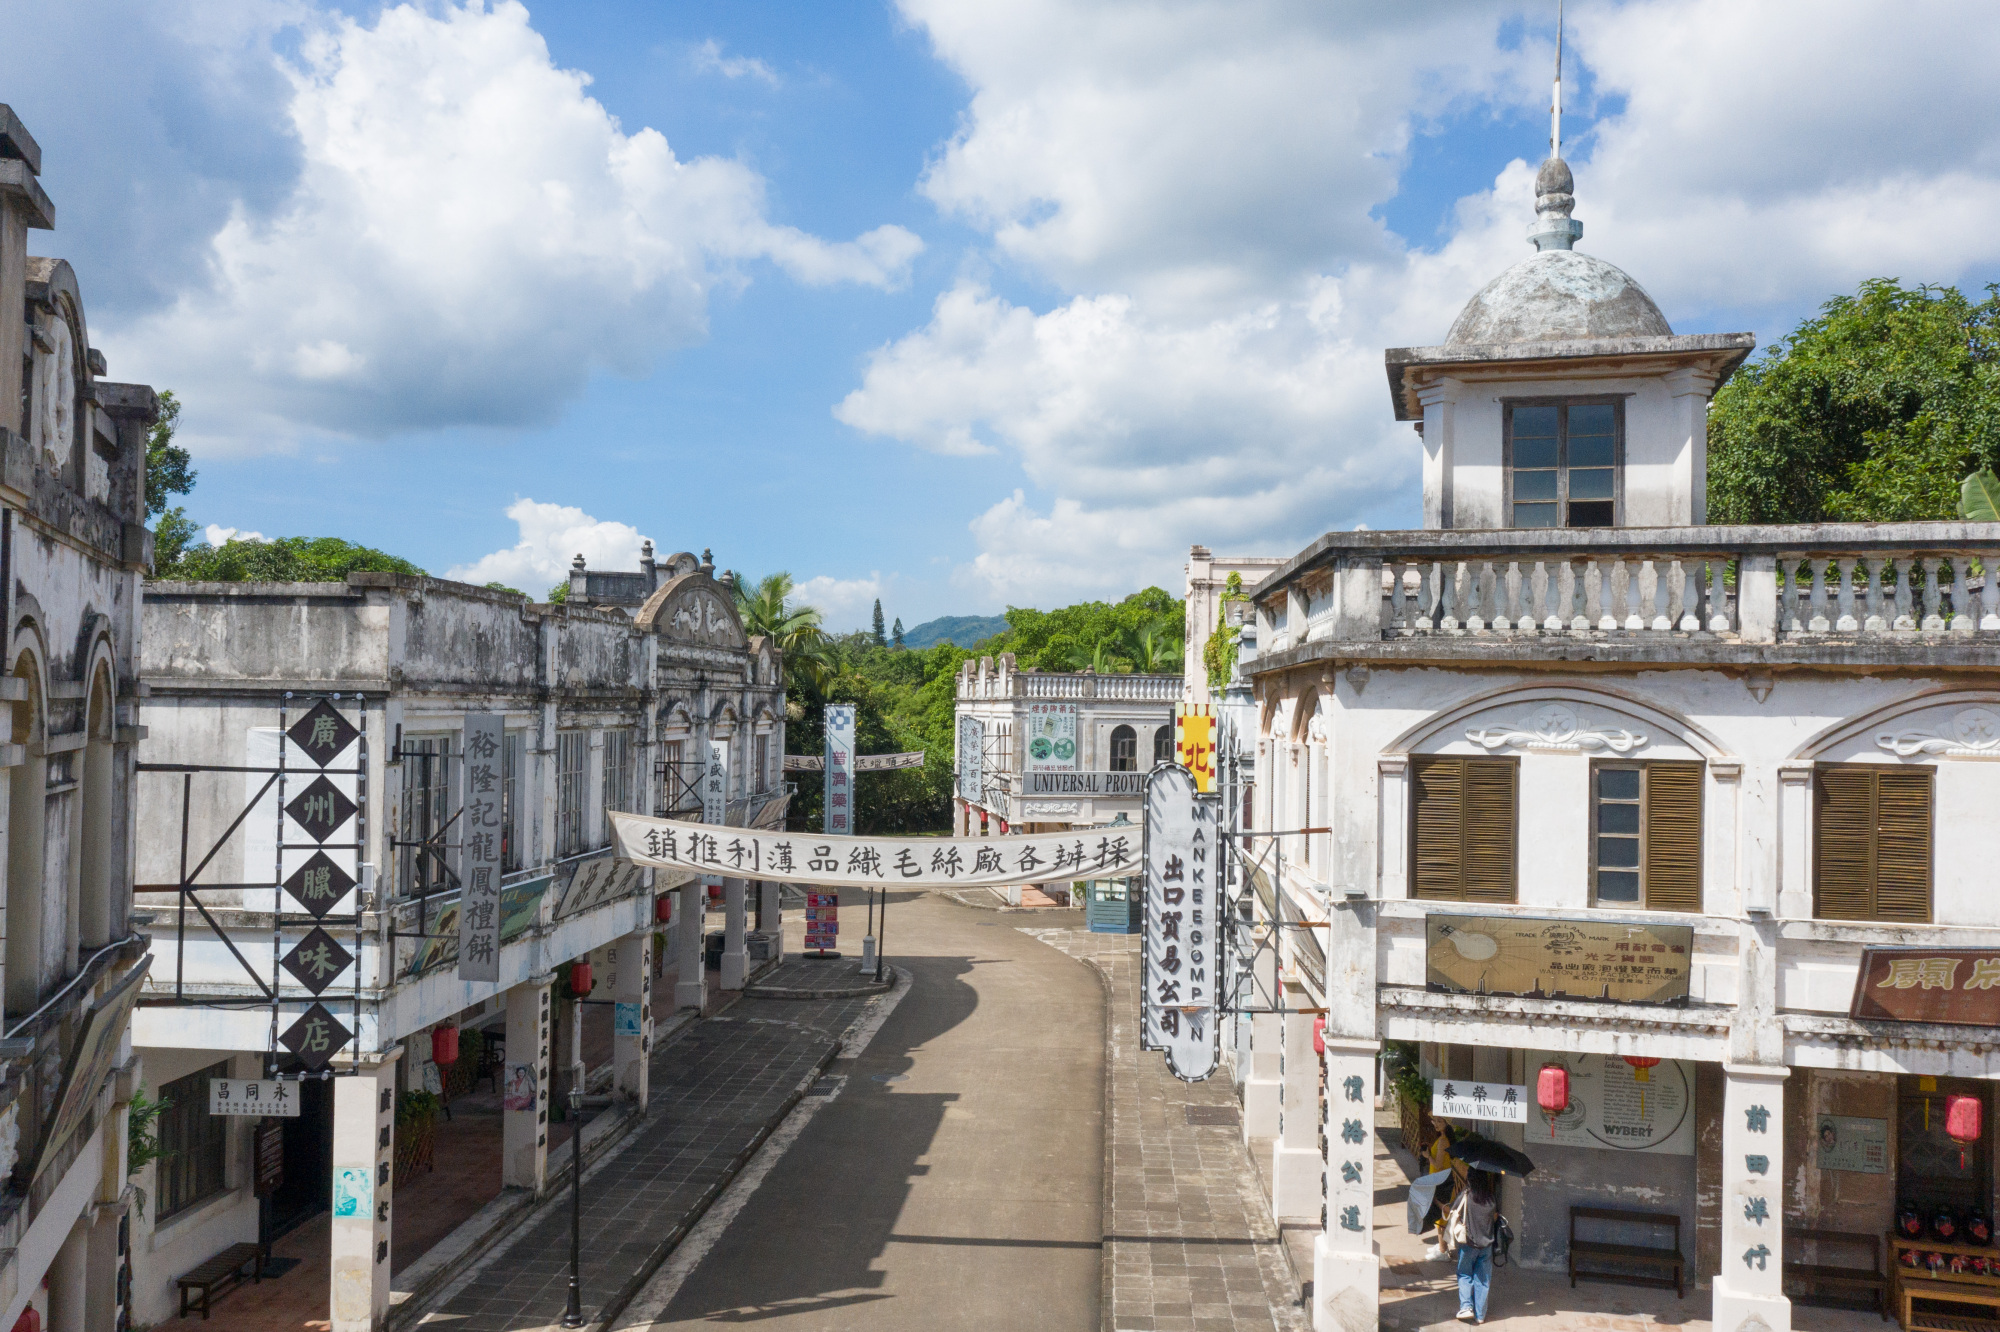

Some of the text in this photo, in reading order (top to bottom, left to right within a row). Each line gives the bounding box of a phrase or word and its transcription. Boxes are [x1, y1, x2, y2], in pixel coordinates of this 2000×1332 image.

[831, 750, 848, 829] 普濟藥房
[1033, 773, 1099, 793] UNIVERSAL
[1184, 741, 1208, 772] 北
[465, 729, 500, 966] 裕隆記龍鳳禮餅
[1157, 853, 1185, 1039] 出口貿易公司
[1442, 1101, 1517, 1119] KWONG WING TAI
[1603, 1124, 1654, 1138] WYBERT
[1341, 1074, 1368, 1232] 價格公道
[1741, 1104, 1772, 1271] 前田洋行
